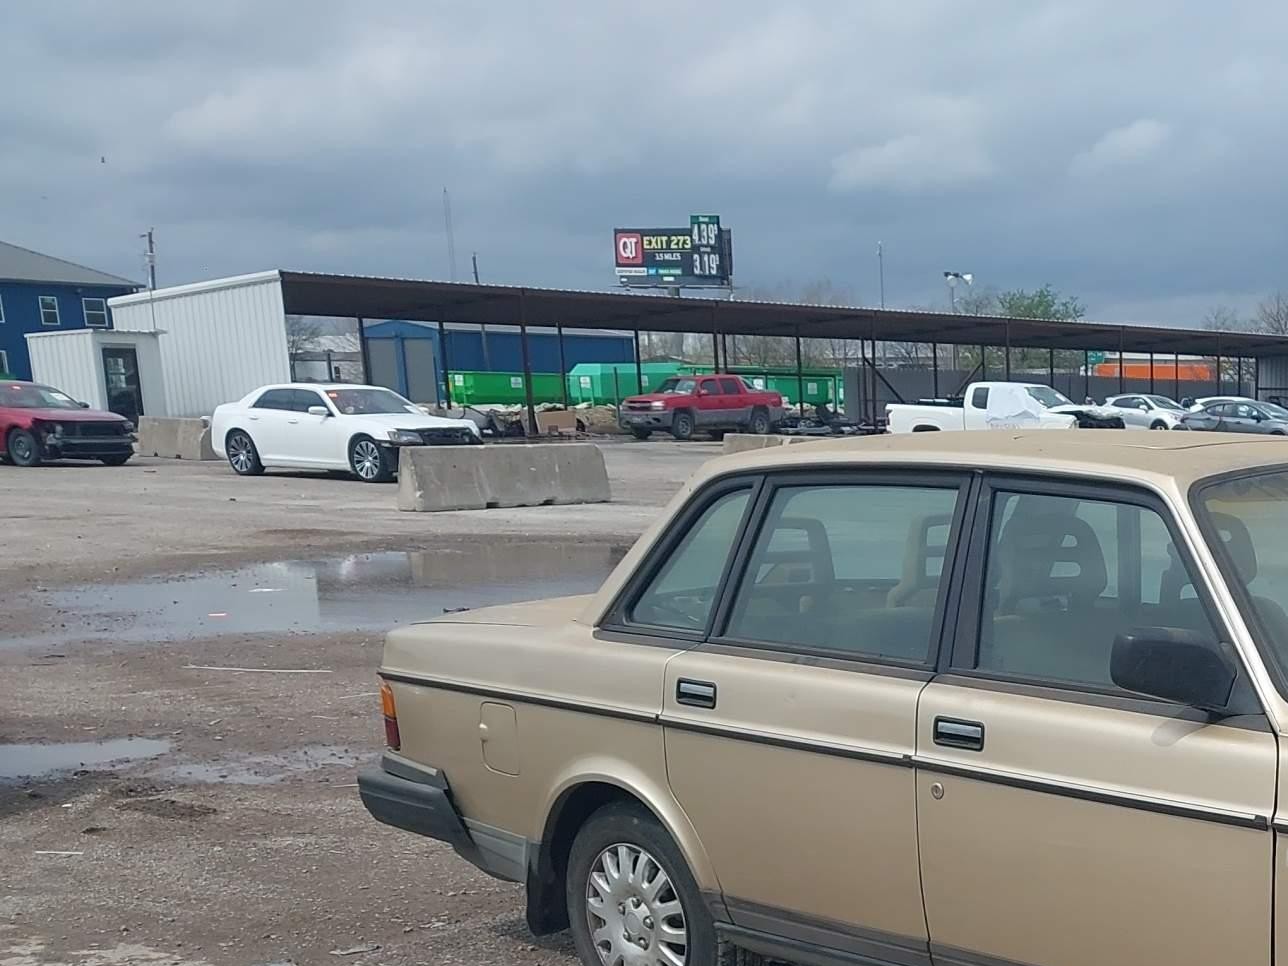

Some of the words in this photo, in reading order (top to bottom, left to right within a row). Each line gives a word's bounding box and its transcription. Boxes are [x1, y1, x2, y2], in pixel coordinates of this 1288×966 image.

[619, 237, 637, 259] QT
[643, 235, 668, 248] EXIT
[670, 235, 691, 248] 273
